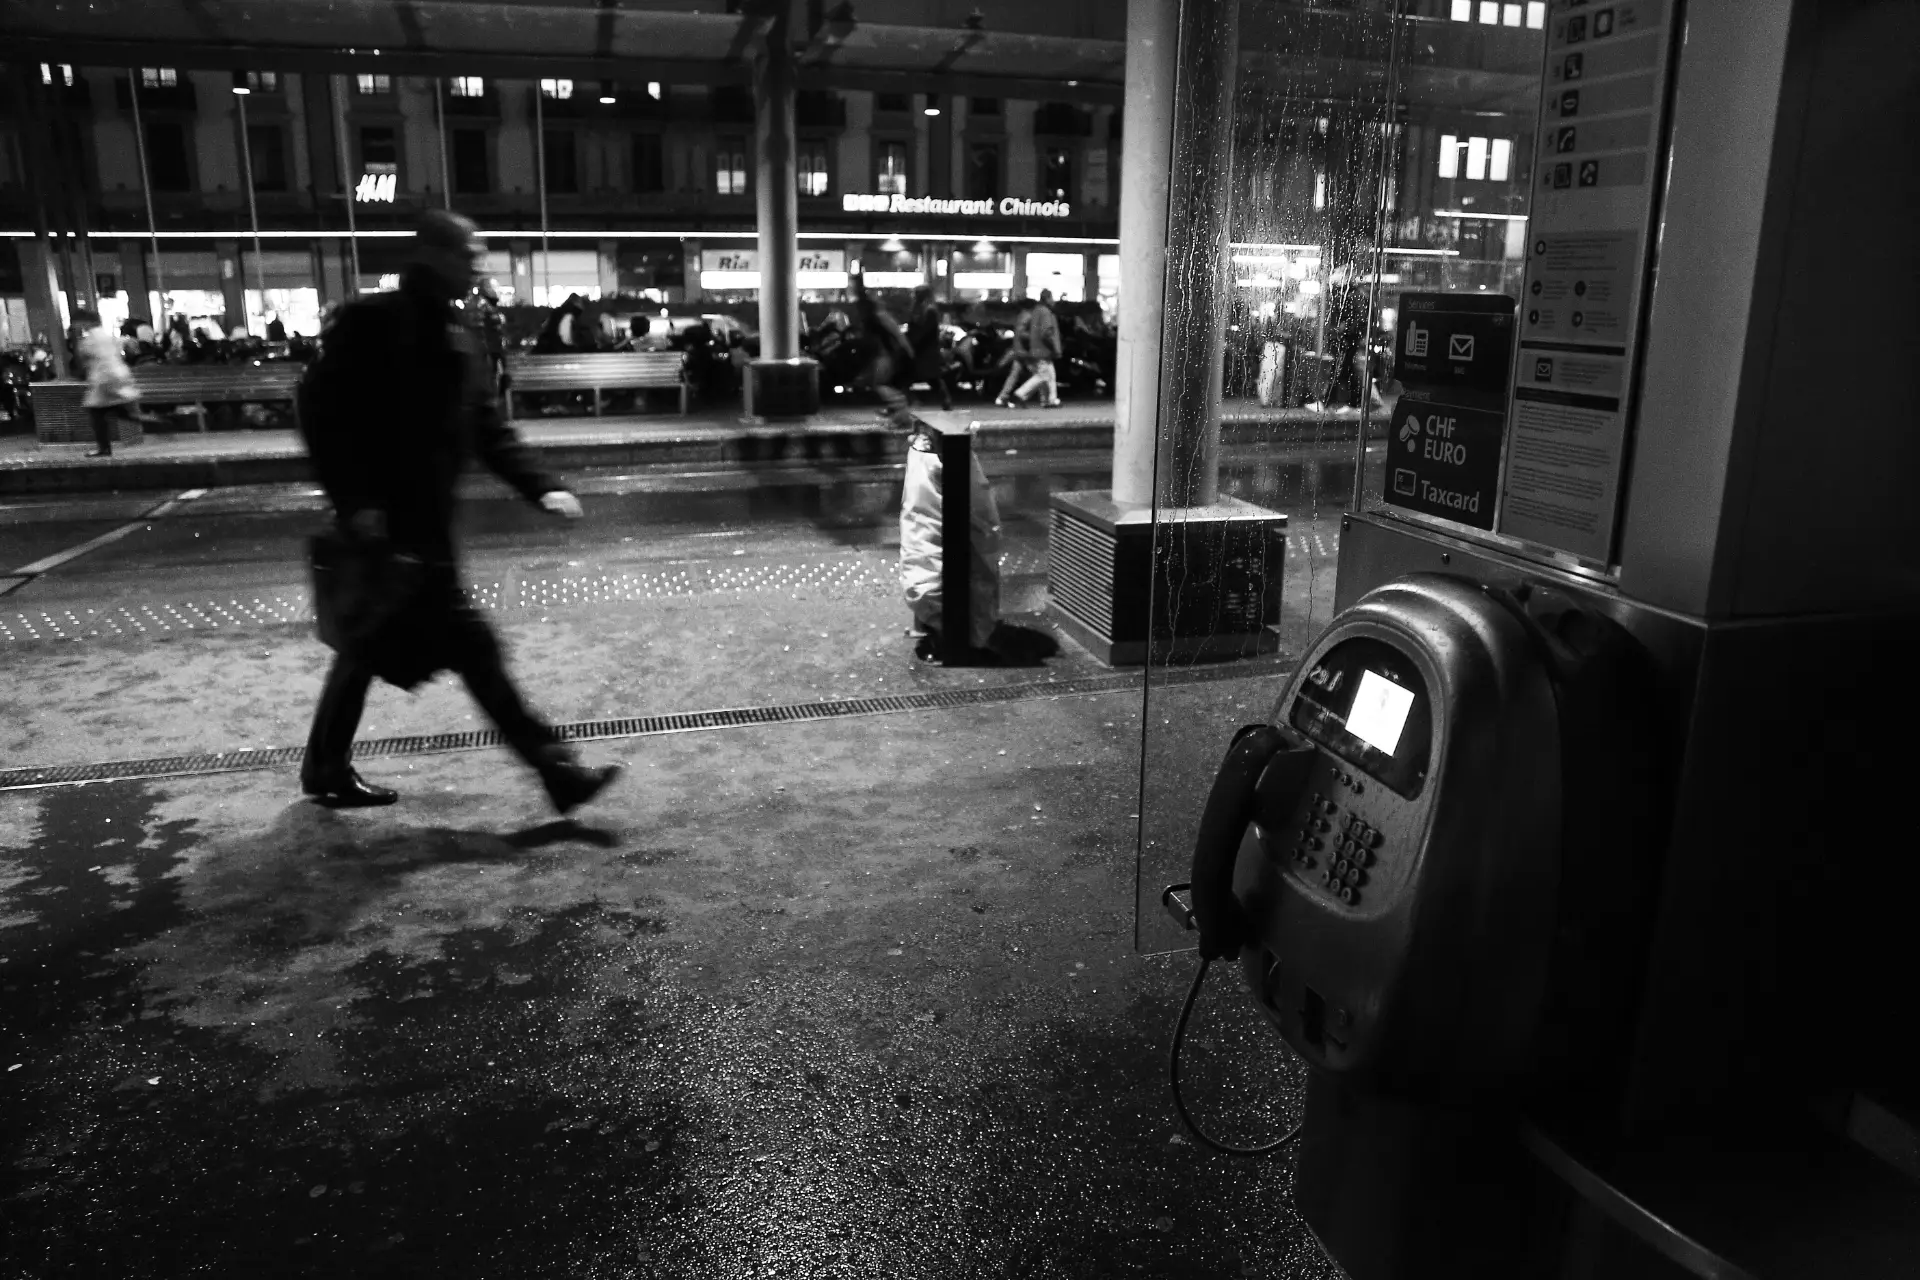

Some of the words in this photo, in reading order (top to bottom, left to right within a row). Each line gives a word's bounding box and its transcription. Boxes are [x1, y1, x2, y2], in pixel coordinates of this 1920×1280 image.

[889, 193, 995, 215] Restaurant
[999, 197, 1071, 216] Chinois
[718, 254, 749, 270] Ria
[798, 254, 830, 270] Ria
[1425, 414, 1457, 439] CHF
[1424, 438, 1467, 466] EURO
[1421, 479, 1481, 514] Taxcard
